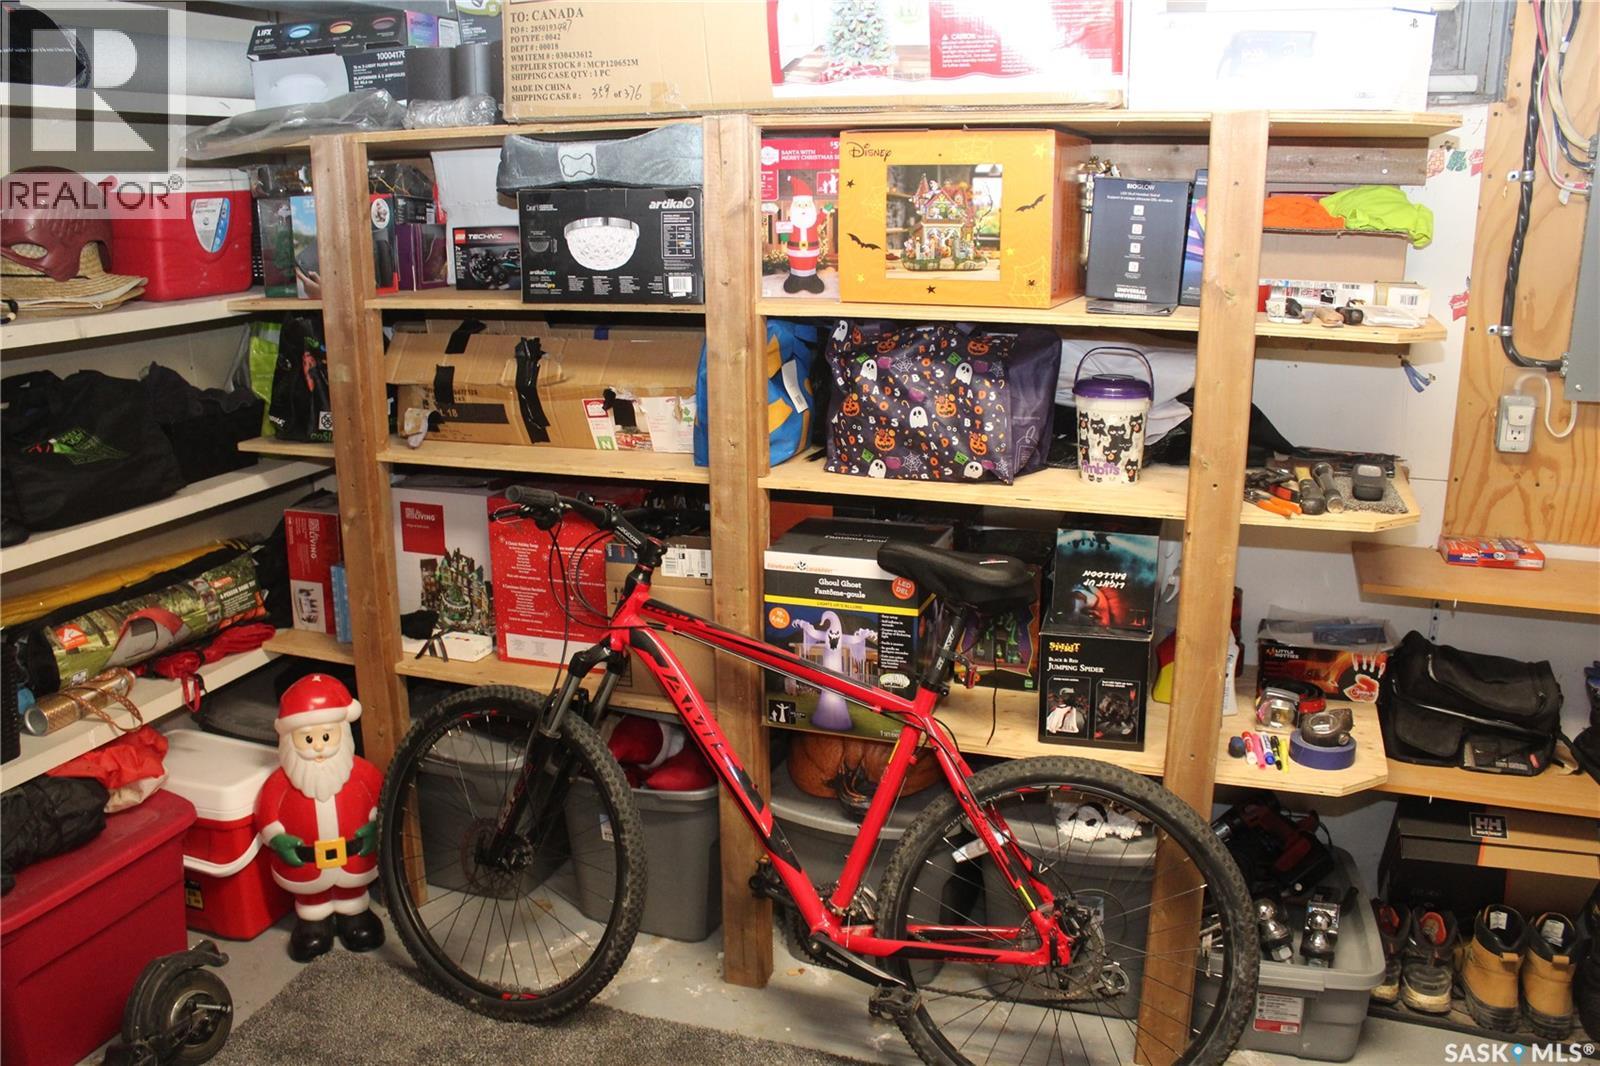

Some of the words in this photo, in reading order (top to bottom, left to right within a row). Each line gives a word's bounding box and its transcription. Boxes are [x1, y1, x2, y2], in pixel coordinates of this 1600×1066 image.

[511, 12, 529, 23] TO:
[532, 8, 584, 22] CANADA
[256, 28, 272, 36] LIFX
[510, 26, 521, 34] PO
[521, 34, 540, 42] TYPE
[511, 44, 528, 52] DEPT
[511, 62, 547, 72] SUPPLIER
[549, 61, 576, 70] STOCK
[511, 73, 547, 81] SHIPPING
[571, 70, 588, 78] QTY
[649, 198, 688, 209] artika
[1082, 570, 1127, 580] BALLOON
[819, 578, 839, 587] Ghoul
[841, 580, 862, 589] Ghost
[898, 579, 911, 588] LED
[1083, 578, 1096, 587] UP
[1096, 580, 1125, 590] LIGHT
[814, 587, 866, 599] Fantôme-goule
[896, 587, 908, 596] DEL
[1476, 817, 1502, 831] HH
